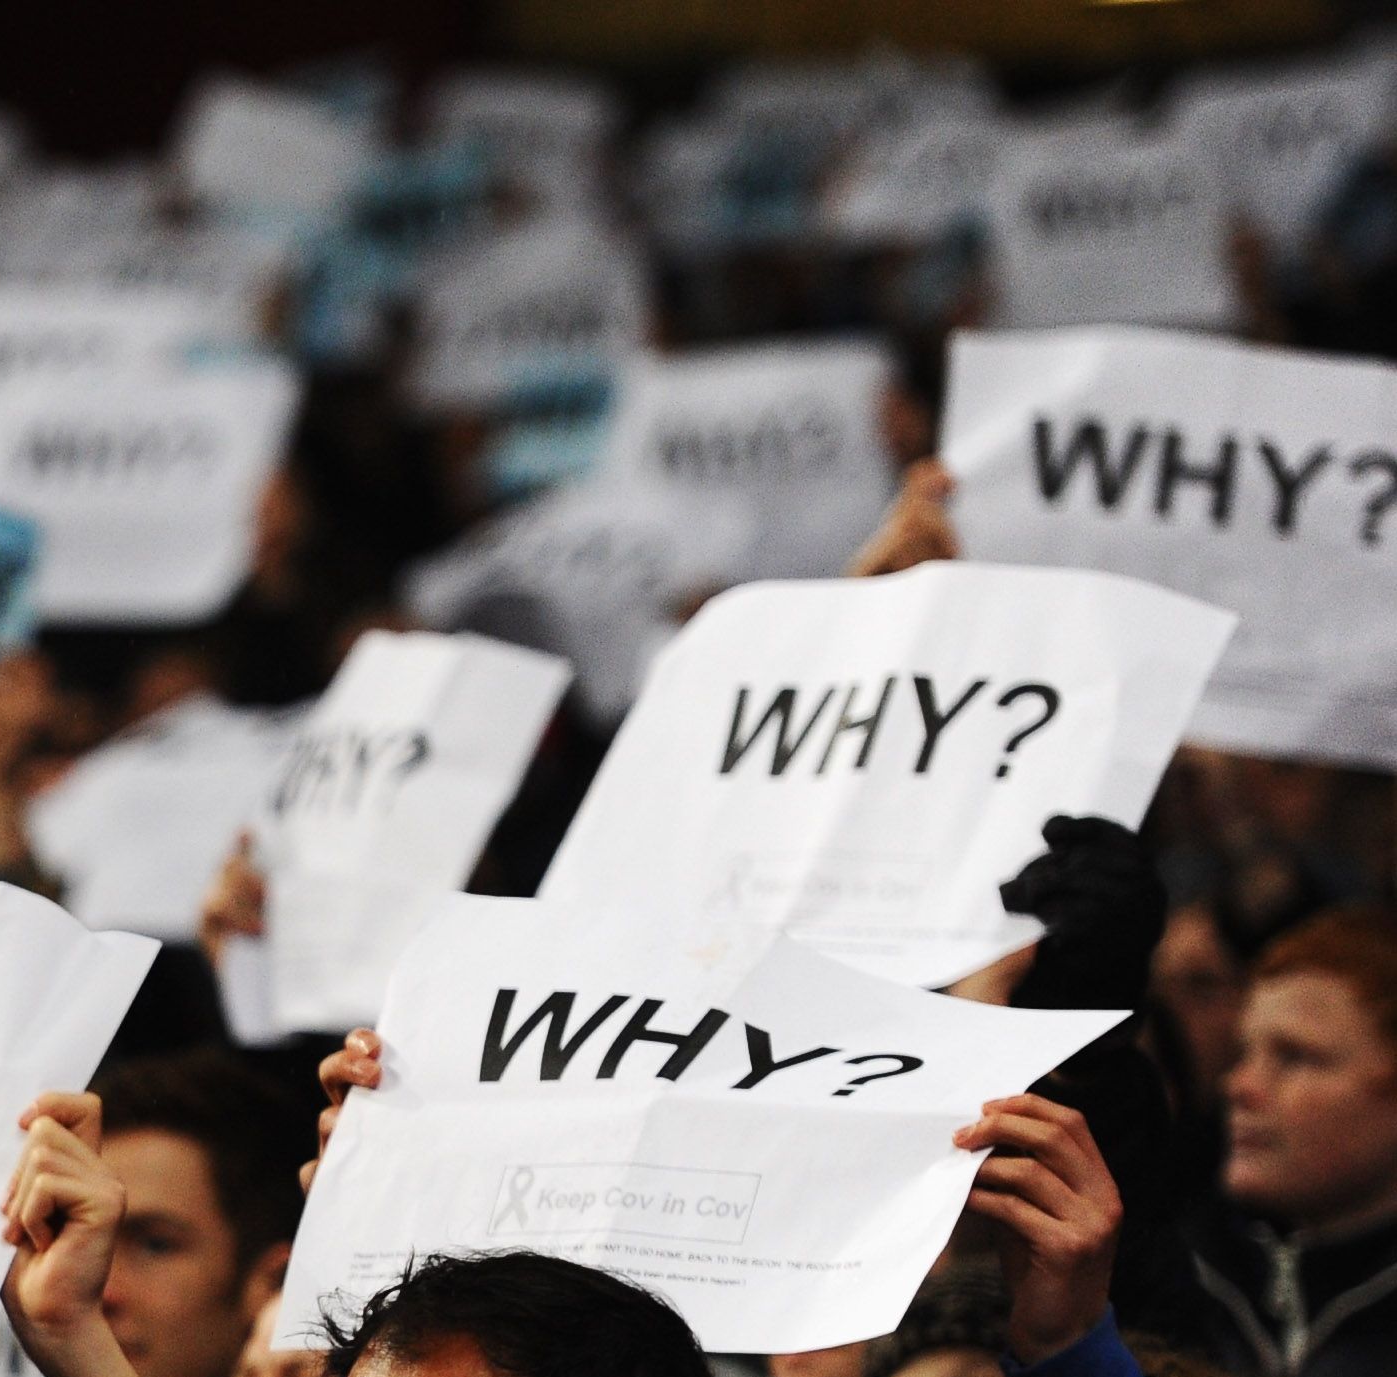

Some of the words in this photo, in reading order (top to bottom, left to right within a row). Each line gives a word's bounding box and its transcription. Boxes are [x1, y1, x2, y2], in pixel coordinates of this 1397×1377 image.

[1029, 415, 1397, 550] WHY?
[718, 674, 1062, 780] WHY?
[478, 987, 925, 1098] WHY?
[537, 1188, 596, 1214] Keep
[604, 1186, 655, 1211] Cov
[661, 1192, 685, 1215] in
[696, 1195, 749, 1220] Cov
